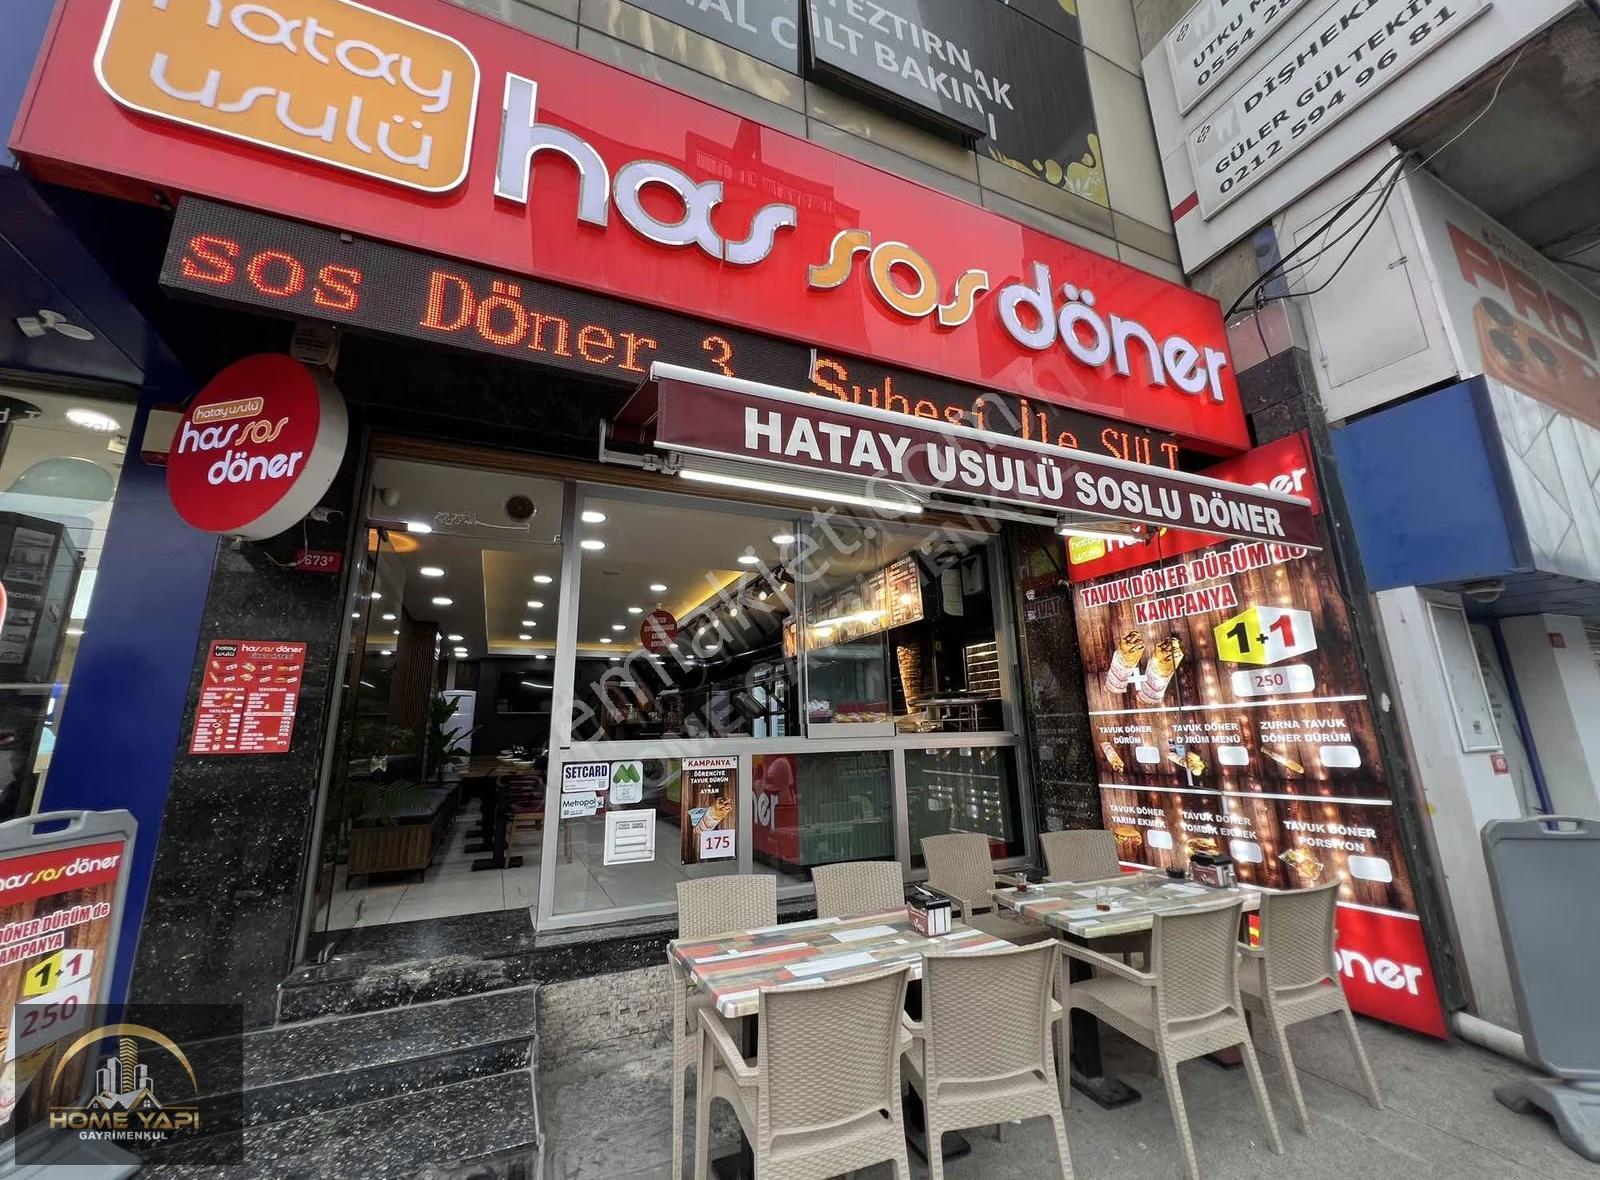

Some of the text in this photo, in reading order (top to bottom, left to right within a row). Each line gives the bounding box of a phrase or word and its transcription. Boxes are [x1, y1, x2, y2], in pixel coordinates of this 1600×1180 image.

[1193, 13, 1244, 68] UTKU
[1198, 27, 1256, 86] 0554
[150, 53, 432, 170] usulü
[1219, 6, 1456, 194] 0212 594 96 81
[1215, 109, 1290, 173] GÜLER
[494, 72, 1229, 403] has sos döner
[420, 271, 657, 373] Döner
[178, 417, 289, 454] has sos
[208, 450, 303, 485] döner
[743, 406, 1285, 537] HATAY USULÜ SOSLU DÖNER
[1082, 579, 1130, 608] TAVUK
[1132, 562, 1189, 595] DÖNER
[1192, 542, 1268, 582] DÜRÜM
[1135, 584, 1238, 624] KAMPANYA
[1255, 673, 1284, 688] 250
[1100, 724, 1152, 734] TAVUK DÖNER
[1172, 721, 1239, 733] TAVUK DÖNER
[1211, 733, 1241, 744] MENÜ
[1260, 718, 1346, 730] ZURNA TAVUK
[1261, 731, 1352, 743] DÖNER DÜRÜM
[1113, 735, 1142, 745] DÜRÜM
[565, 765, 608, 779] SETCARD
[688, 759, 730, 767] KAMPANYA
[1110, 804, 1164, 817] TAVUK DÖNER
[1112, 815, 1136, 826] YARIM
[1183, 811, 1213, 822] TAVUK
[705, 836, 730, 850] 175
[1283, 820, 1377, 839] TAVUK DÖNER
[31, 866, 67, 885] sos
[65, 854, 120, 877] döner
[42, 904, 91, 932] DÜRÜM
[93, 902, 109, 919] de
[0, 932, 63, 965] AMPANYA
[1335, 948, 1423, 996] ner
[19, 994, 78, 1038] 250
